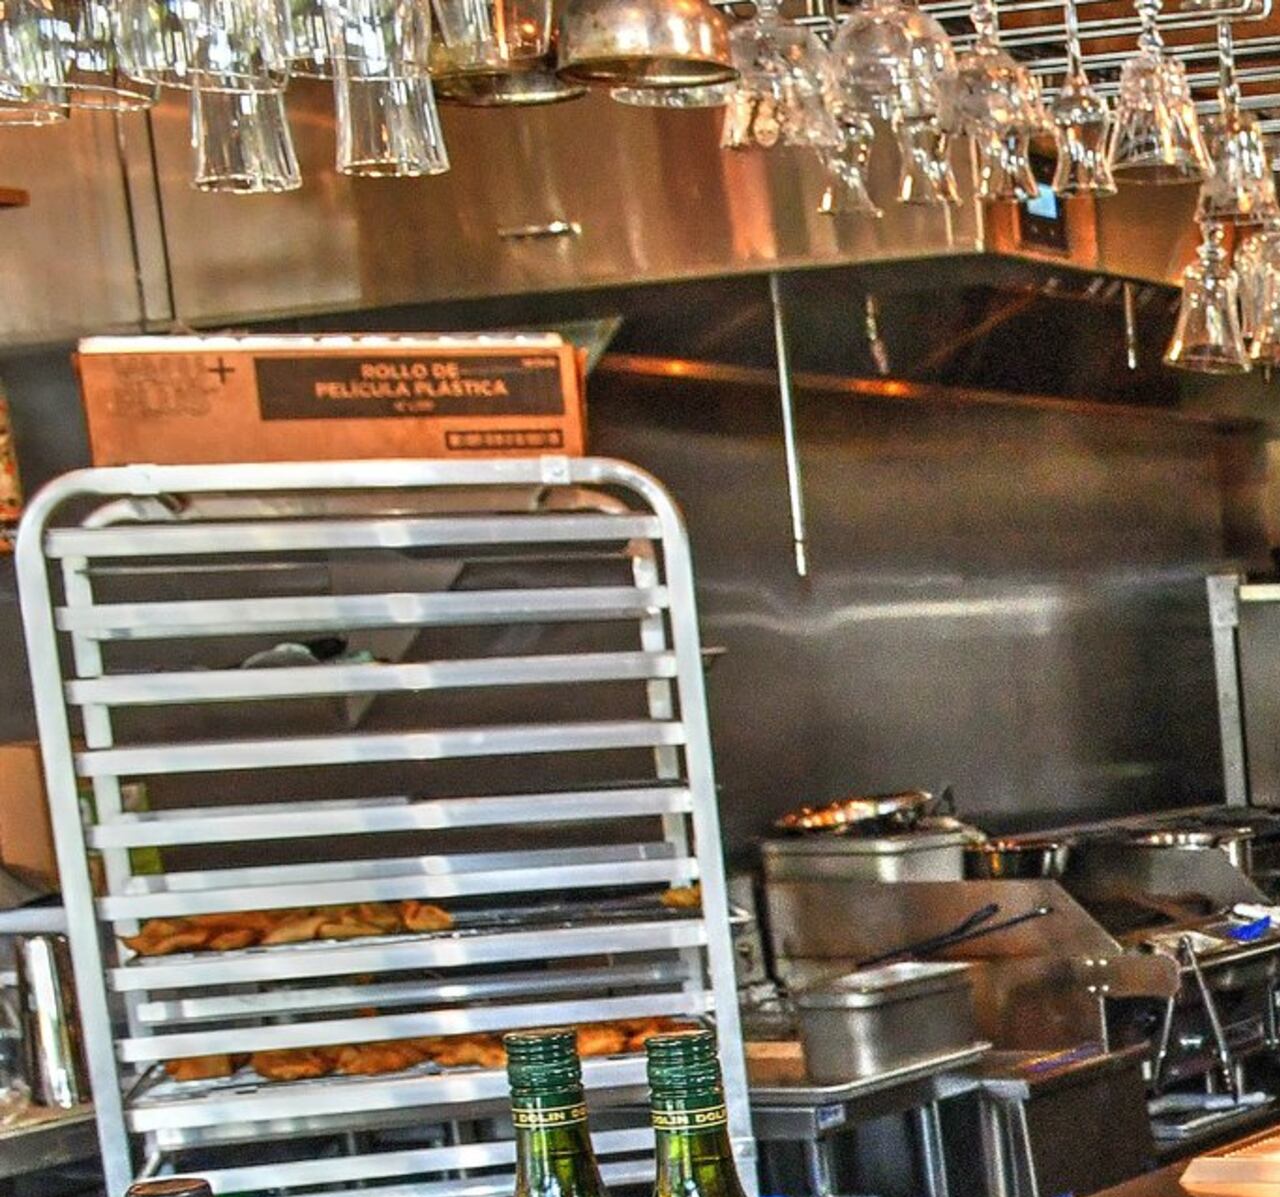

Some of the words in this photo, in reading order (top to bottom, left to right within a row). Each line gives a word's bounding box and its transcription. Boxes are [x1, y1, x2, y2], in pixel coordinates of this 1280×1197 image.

[361, 363, 427, 381] ROLLO
[431, 362, 460, 380] DE
[519, 1112, 566, 1122] DOLIN
